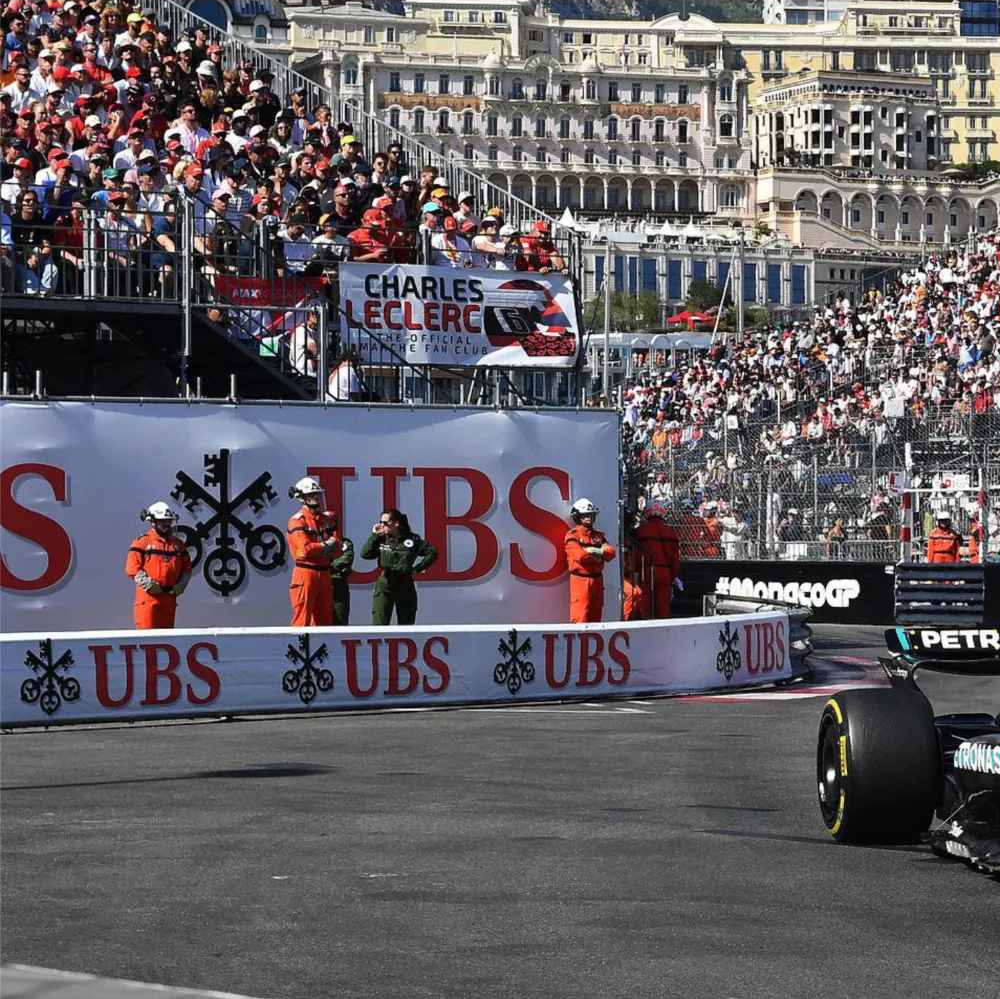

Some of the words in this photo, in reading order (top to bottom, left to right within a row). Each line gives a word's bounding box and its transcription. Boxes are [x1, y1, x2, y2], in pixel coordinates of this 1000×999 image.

[365, 274, 484, 302] CHARLES
[345, 299, 482, 334] LECLERC
[377, 333, 401, 343] THE
[410, 333, 471, 345] OFFICIAL
[425, 345, 448, 354] FAN
[455, 346, 488, 355] CLUB
[305, 465, 572, 584] UBS
[715, 577, 860, 608] #MonacoGP
[341, 636, 451, 698] UBS
[542, 631, 632, 688] UBS
[743, 622, 786, 675] UBS
[88, 642, 221, 708] UBS
